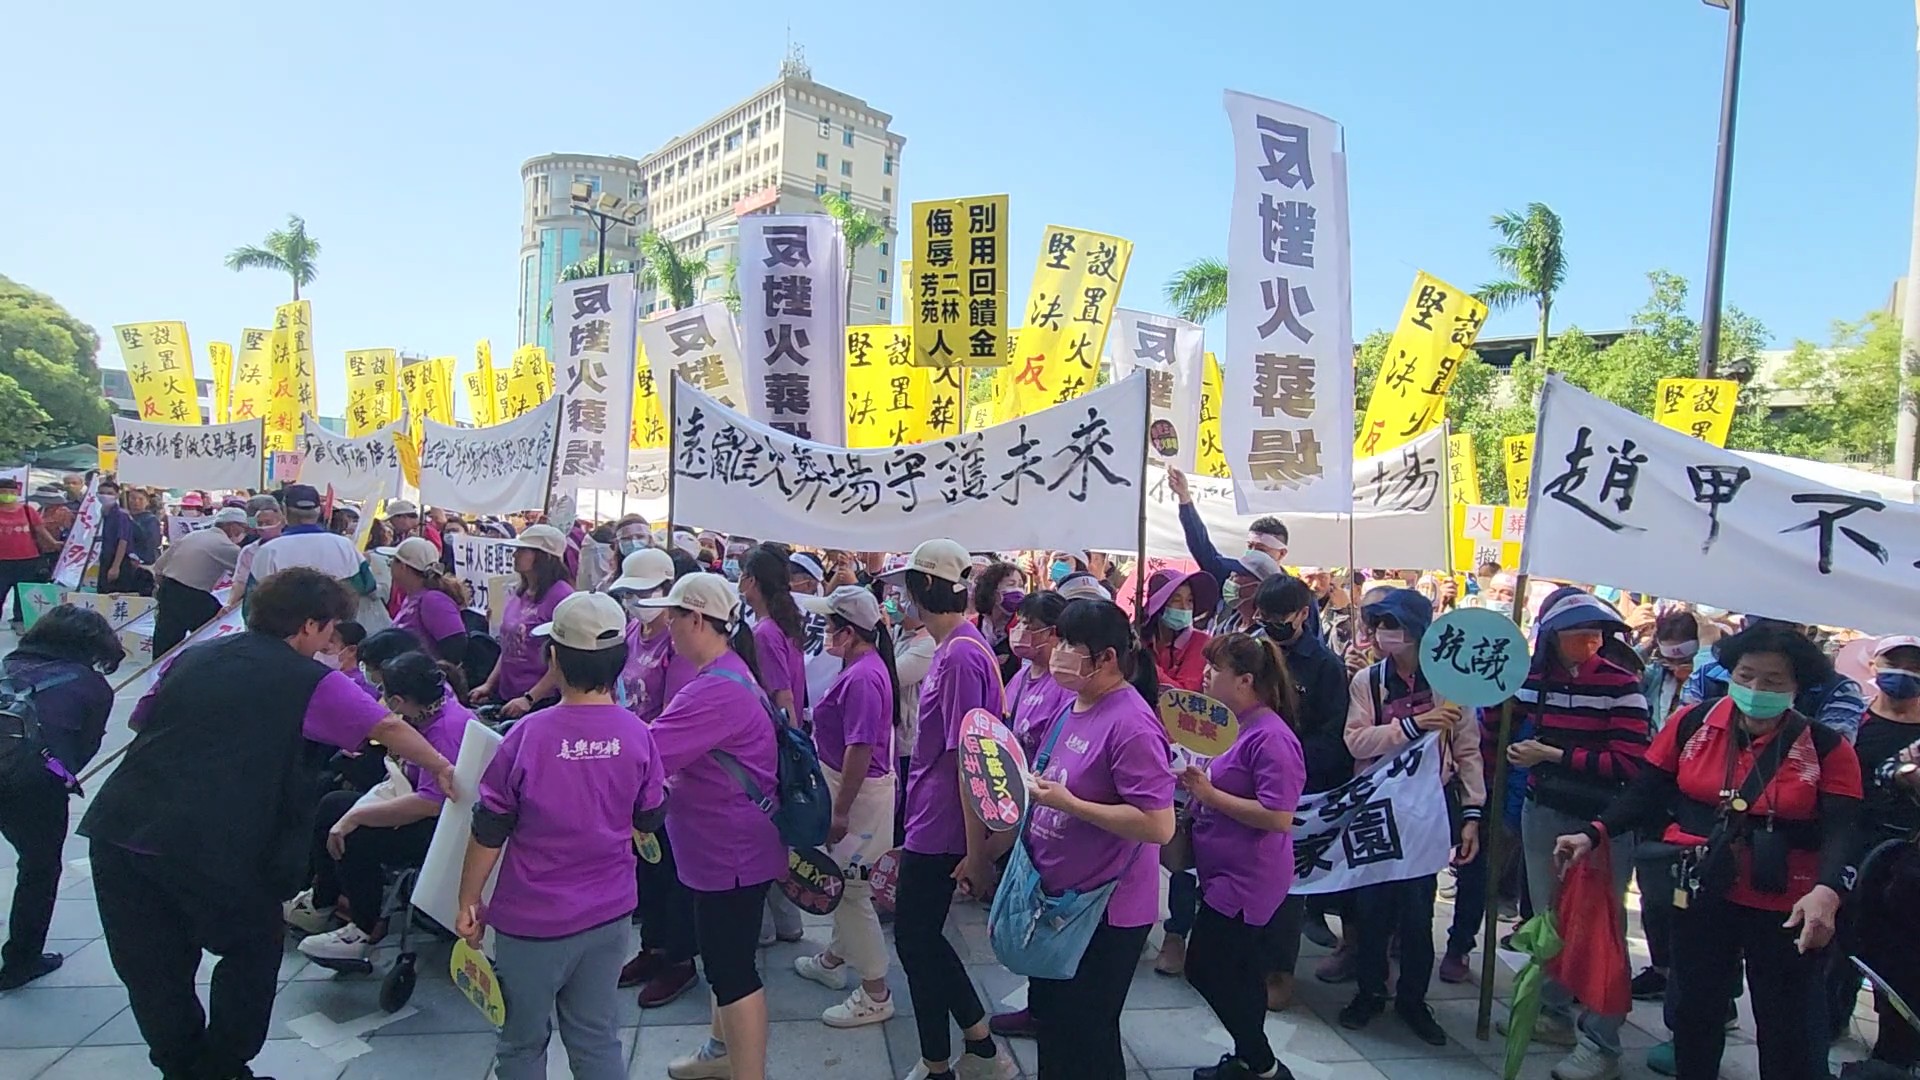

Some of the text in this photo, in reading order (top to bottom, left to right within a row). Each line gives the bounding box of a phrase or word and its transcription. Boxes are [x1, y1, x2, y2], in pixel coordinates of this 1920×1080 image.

[926, 208, 953, 268] 侮辱
[969, 203, 997, 358] 別用回饋金
[920, 273, 939, 324] 芳苑
[928, 329, 954, 358] 人
[942, 273, 960, 324] 二林
[1015, 232, 1076, 392] 堅決反
[122, 328, 164, 418] 堅決反
[150, 326, 192, 421] 設置火葬
[236, 331, 265, 419] 堅決反
[272, 308, 293, 432] 堅決反對
[848, 332, 878, 427] 堅決
[1664, 384, 1685, 414] 堅
[674, 406, 1132, 515] 遠離火葬場守護未來
[1543, 426, 1920, 574] 趙甲不
[1432, 624, 1511, 691] 抗議
